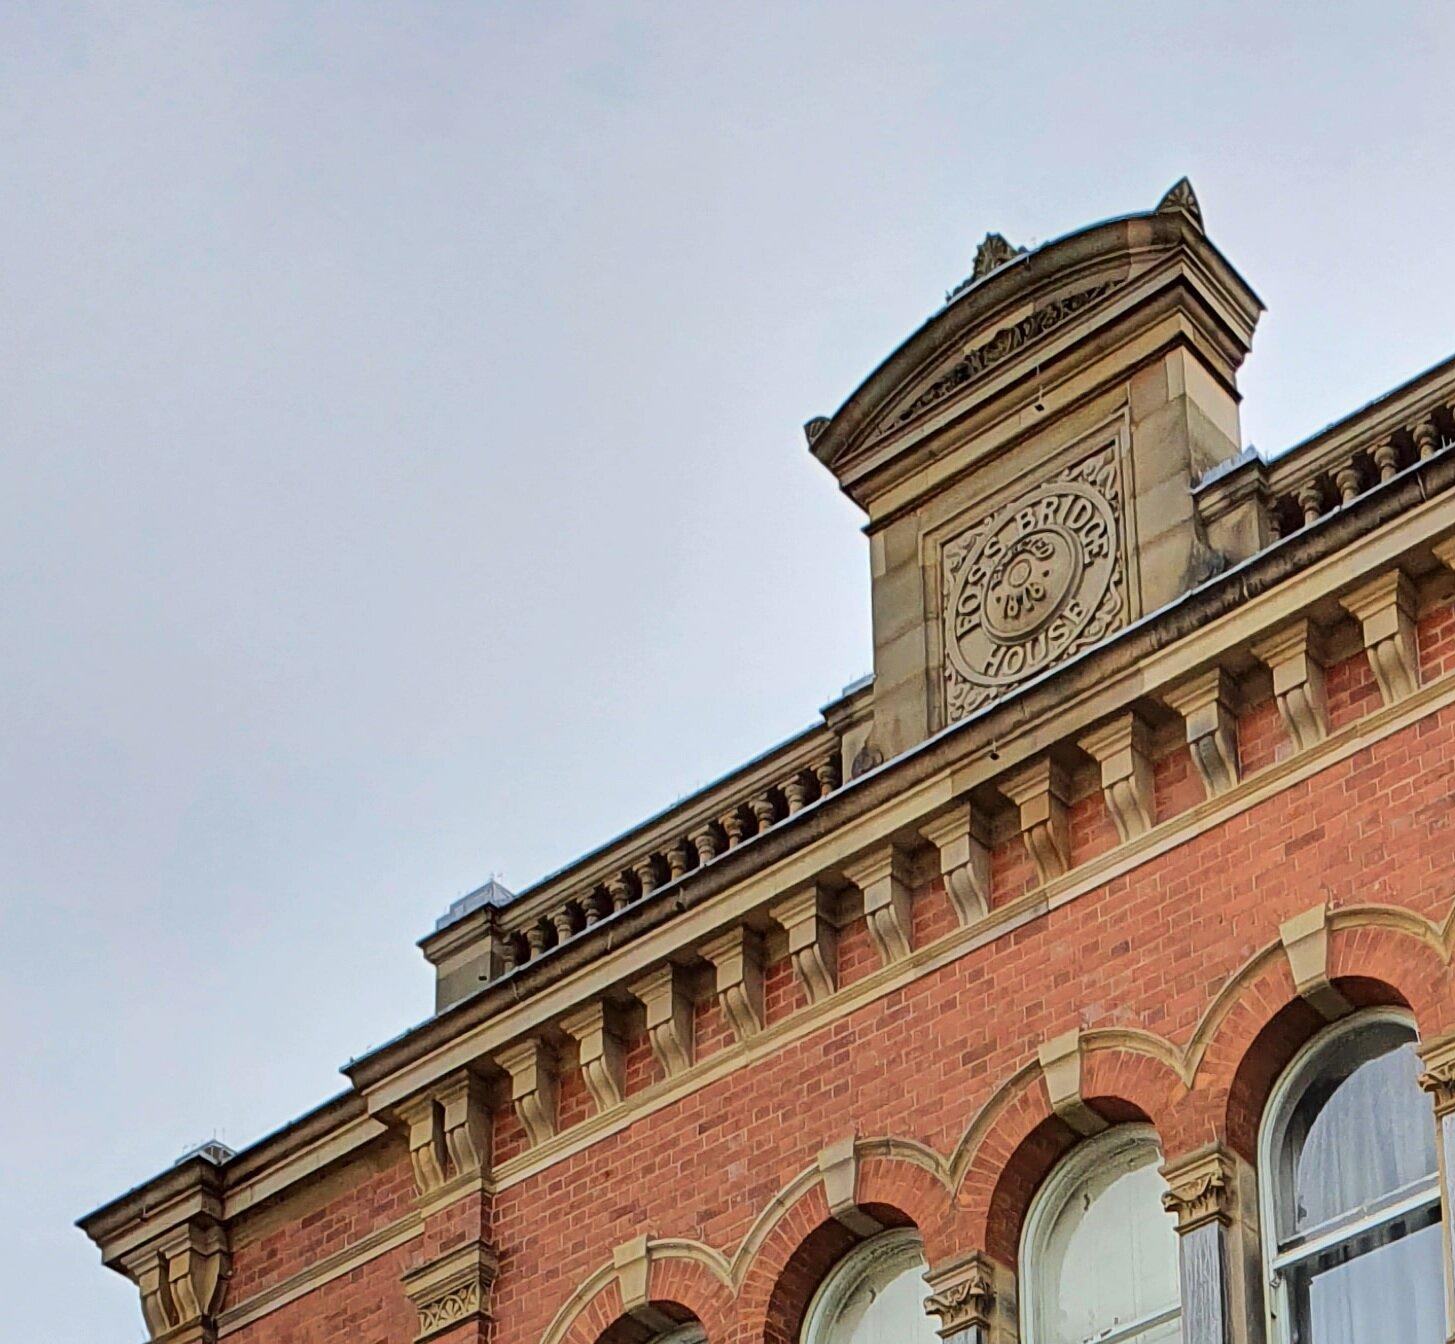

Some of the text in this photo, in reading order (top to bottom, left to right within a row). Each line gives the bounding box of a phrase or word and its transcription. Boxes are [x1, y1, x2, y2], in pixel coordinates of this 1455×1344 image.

[956, 497, 1109, 676] FOSS BRIDGE HOUSE
